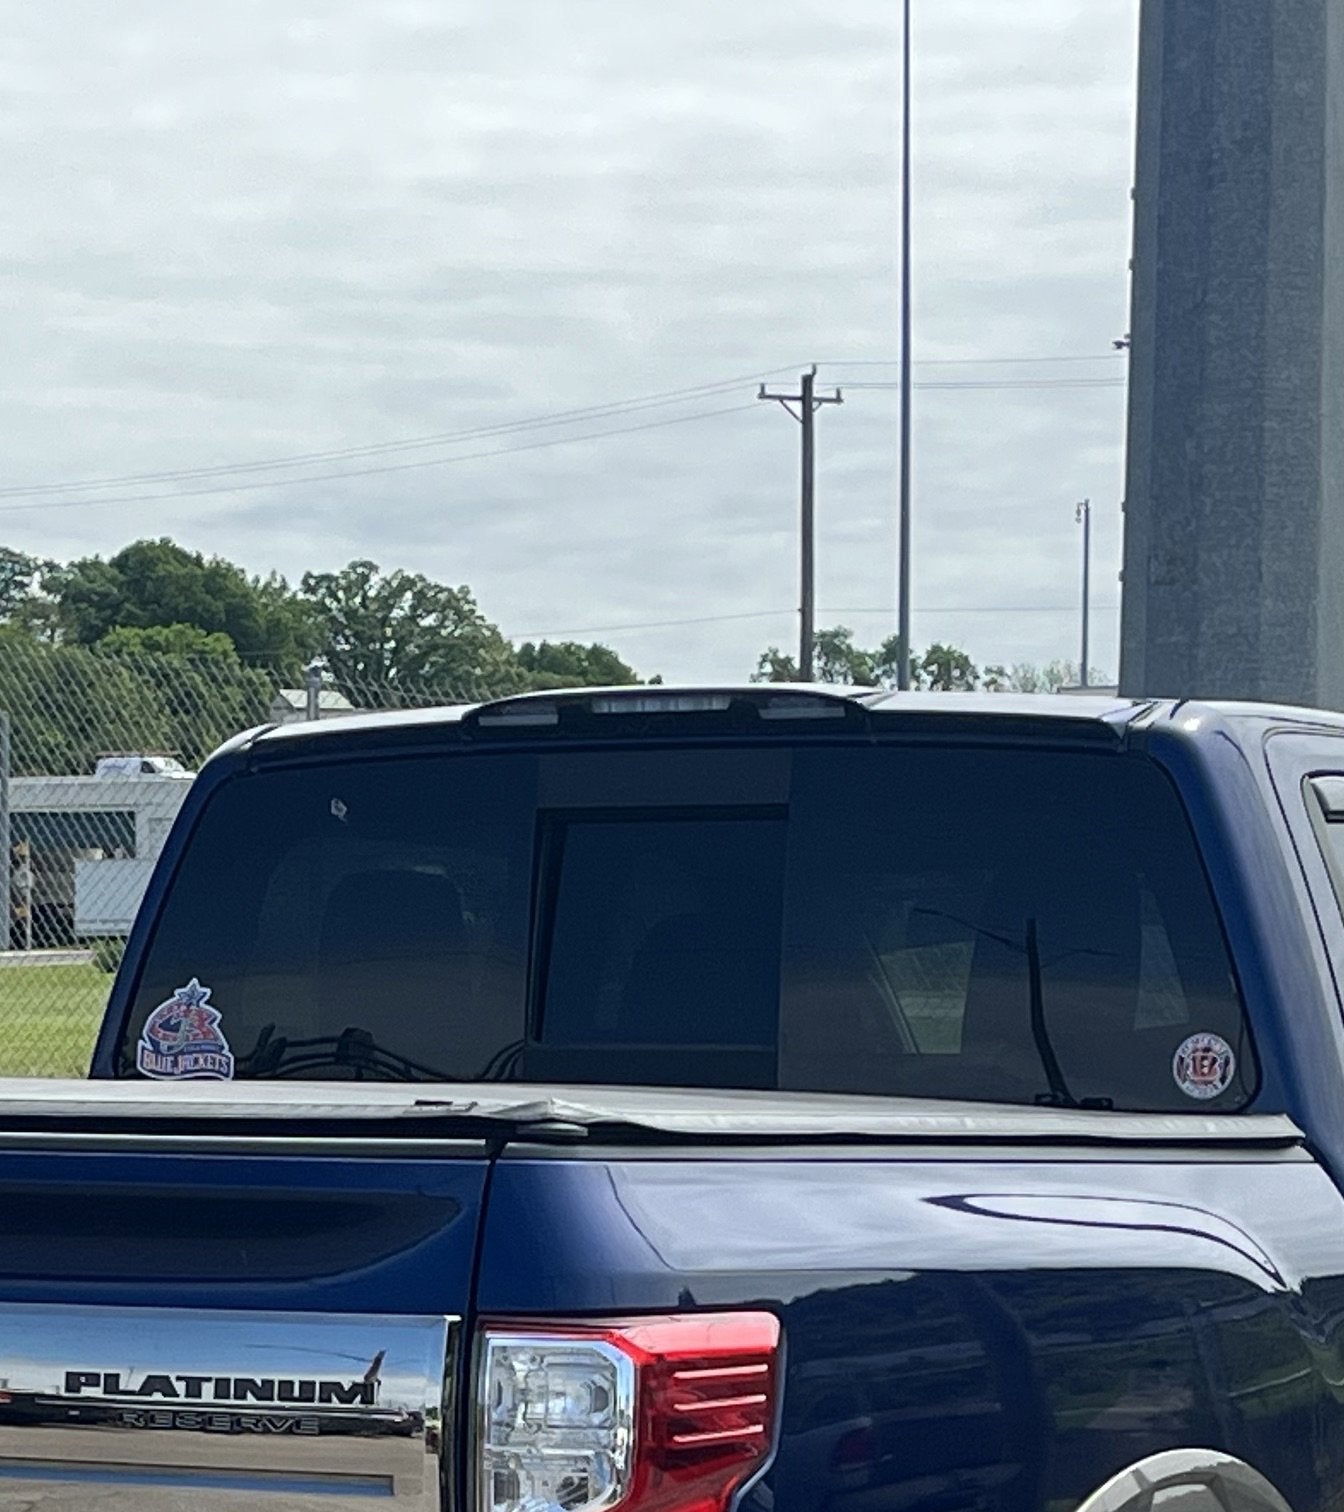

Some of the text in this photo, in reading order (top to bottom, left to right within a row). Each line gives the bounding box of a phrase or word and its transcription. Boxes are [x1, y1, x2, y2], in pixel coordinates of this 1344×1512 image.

[173, 1052, 230, 1076] JACKETS
[65, 1371, 376, 1405] PLATINUM
[120, 1410, 320, 1434] RESERVE
